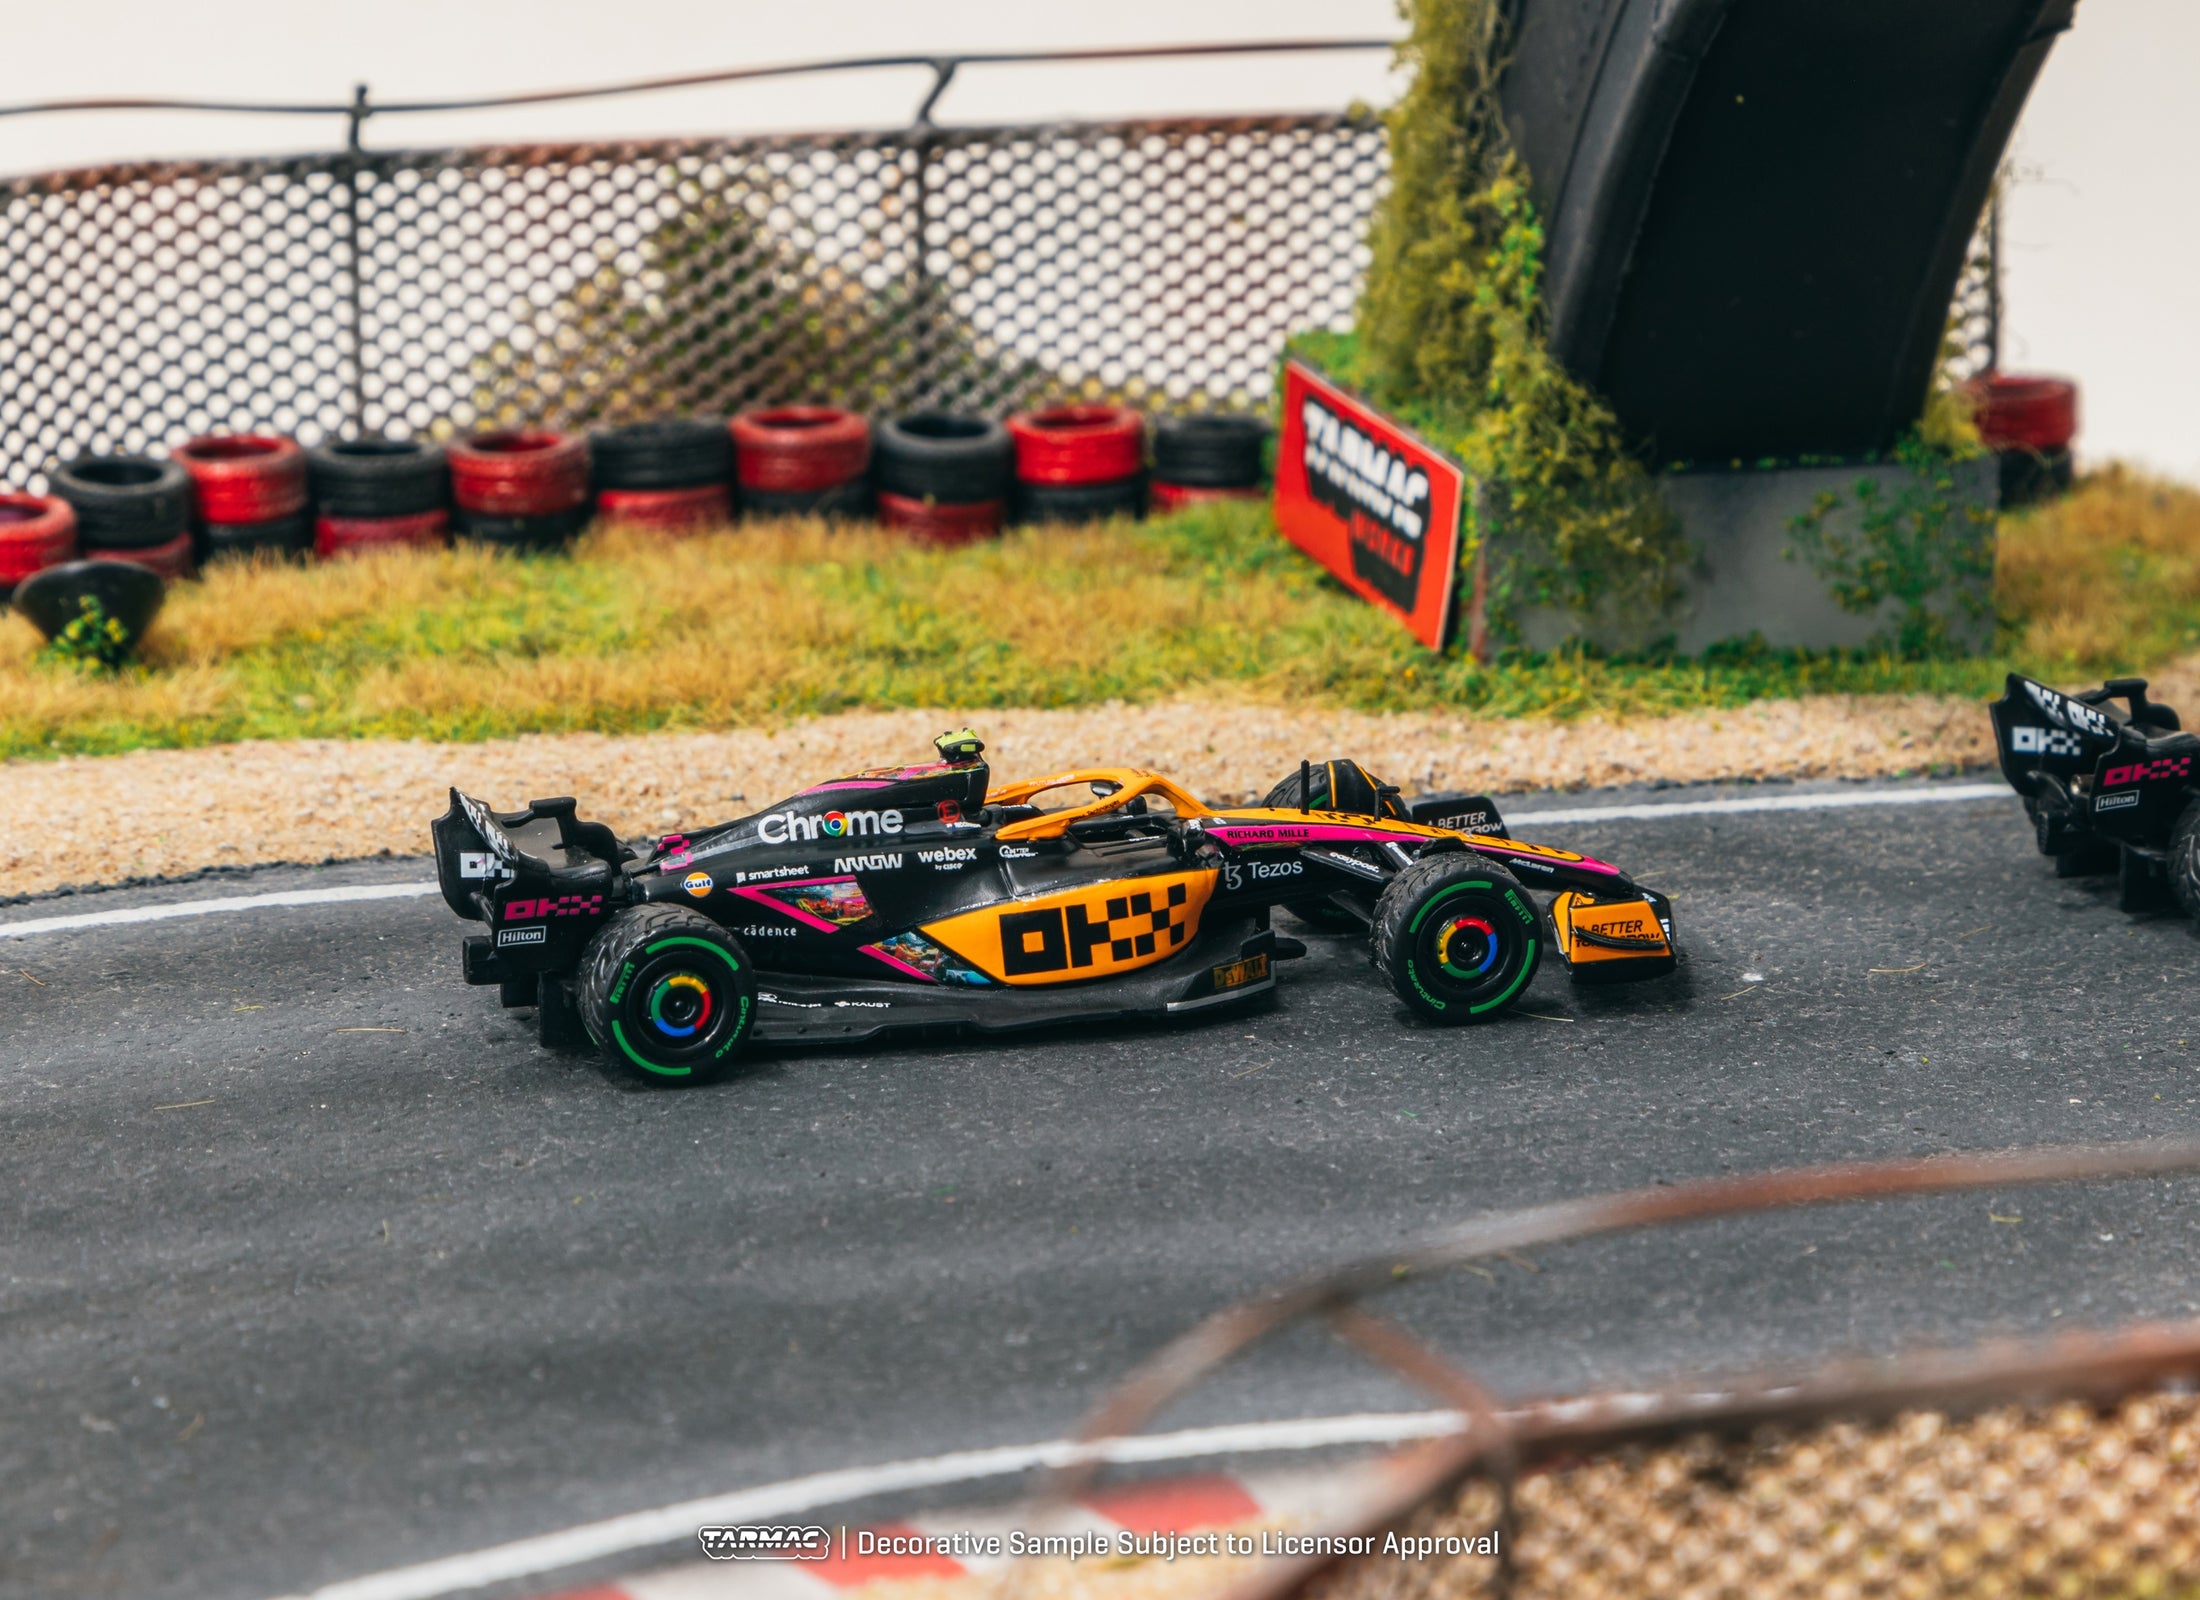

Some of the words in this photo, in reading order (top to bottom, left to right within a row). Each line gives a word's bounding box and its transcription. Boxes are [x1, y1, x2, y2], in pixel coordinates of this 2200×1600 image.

[1303, 399, 1429, 539] TARMAC
[2103, 757, 2192, 787] OKX
[2099, 794, 2136, 807] Hilton
[757, 808, 904, 844] Chrome
[1438, 811, 1486, 829] BETTER
[1227, 829, 1275, 839] RICHARD
[1277, 828, 1309, 838] MILLE
[918, 846, 977, 863] webex
[1329, 851, 1380, 873] easypost
[748, 865, 810, 881] smartsheet
[834, 853, 903, 875] ARROW
[1247, 860, 1304, 879] Tezos
[1508, 858, 1555, 874] McLaren
[685, 878, 712, 889] Gulf
[503, 894, 603, 921] OKX
[998, 882, 1187, 977] OKX
[1591, 919, 1643, 936] BETTER
[502, 931, 542, 943] Hilton
